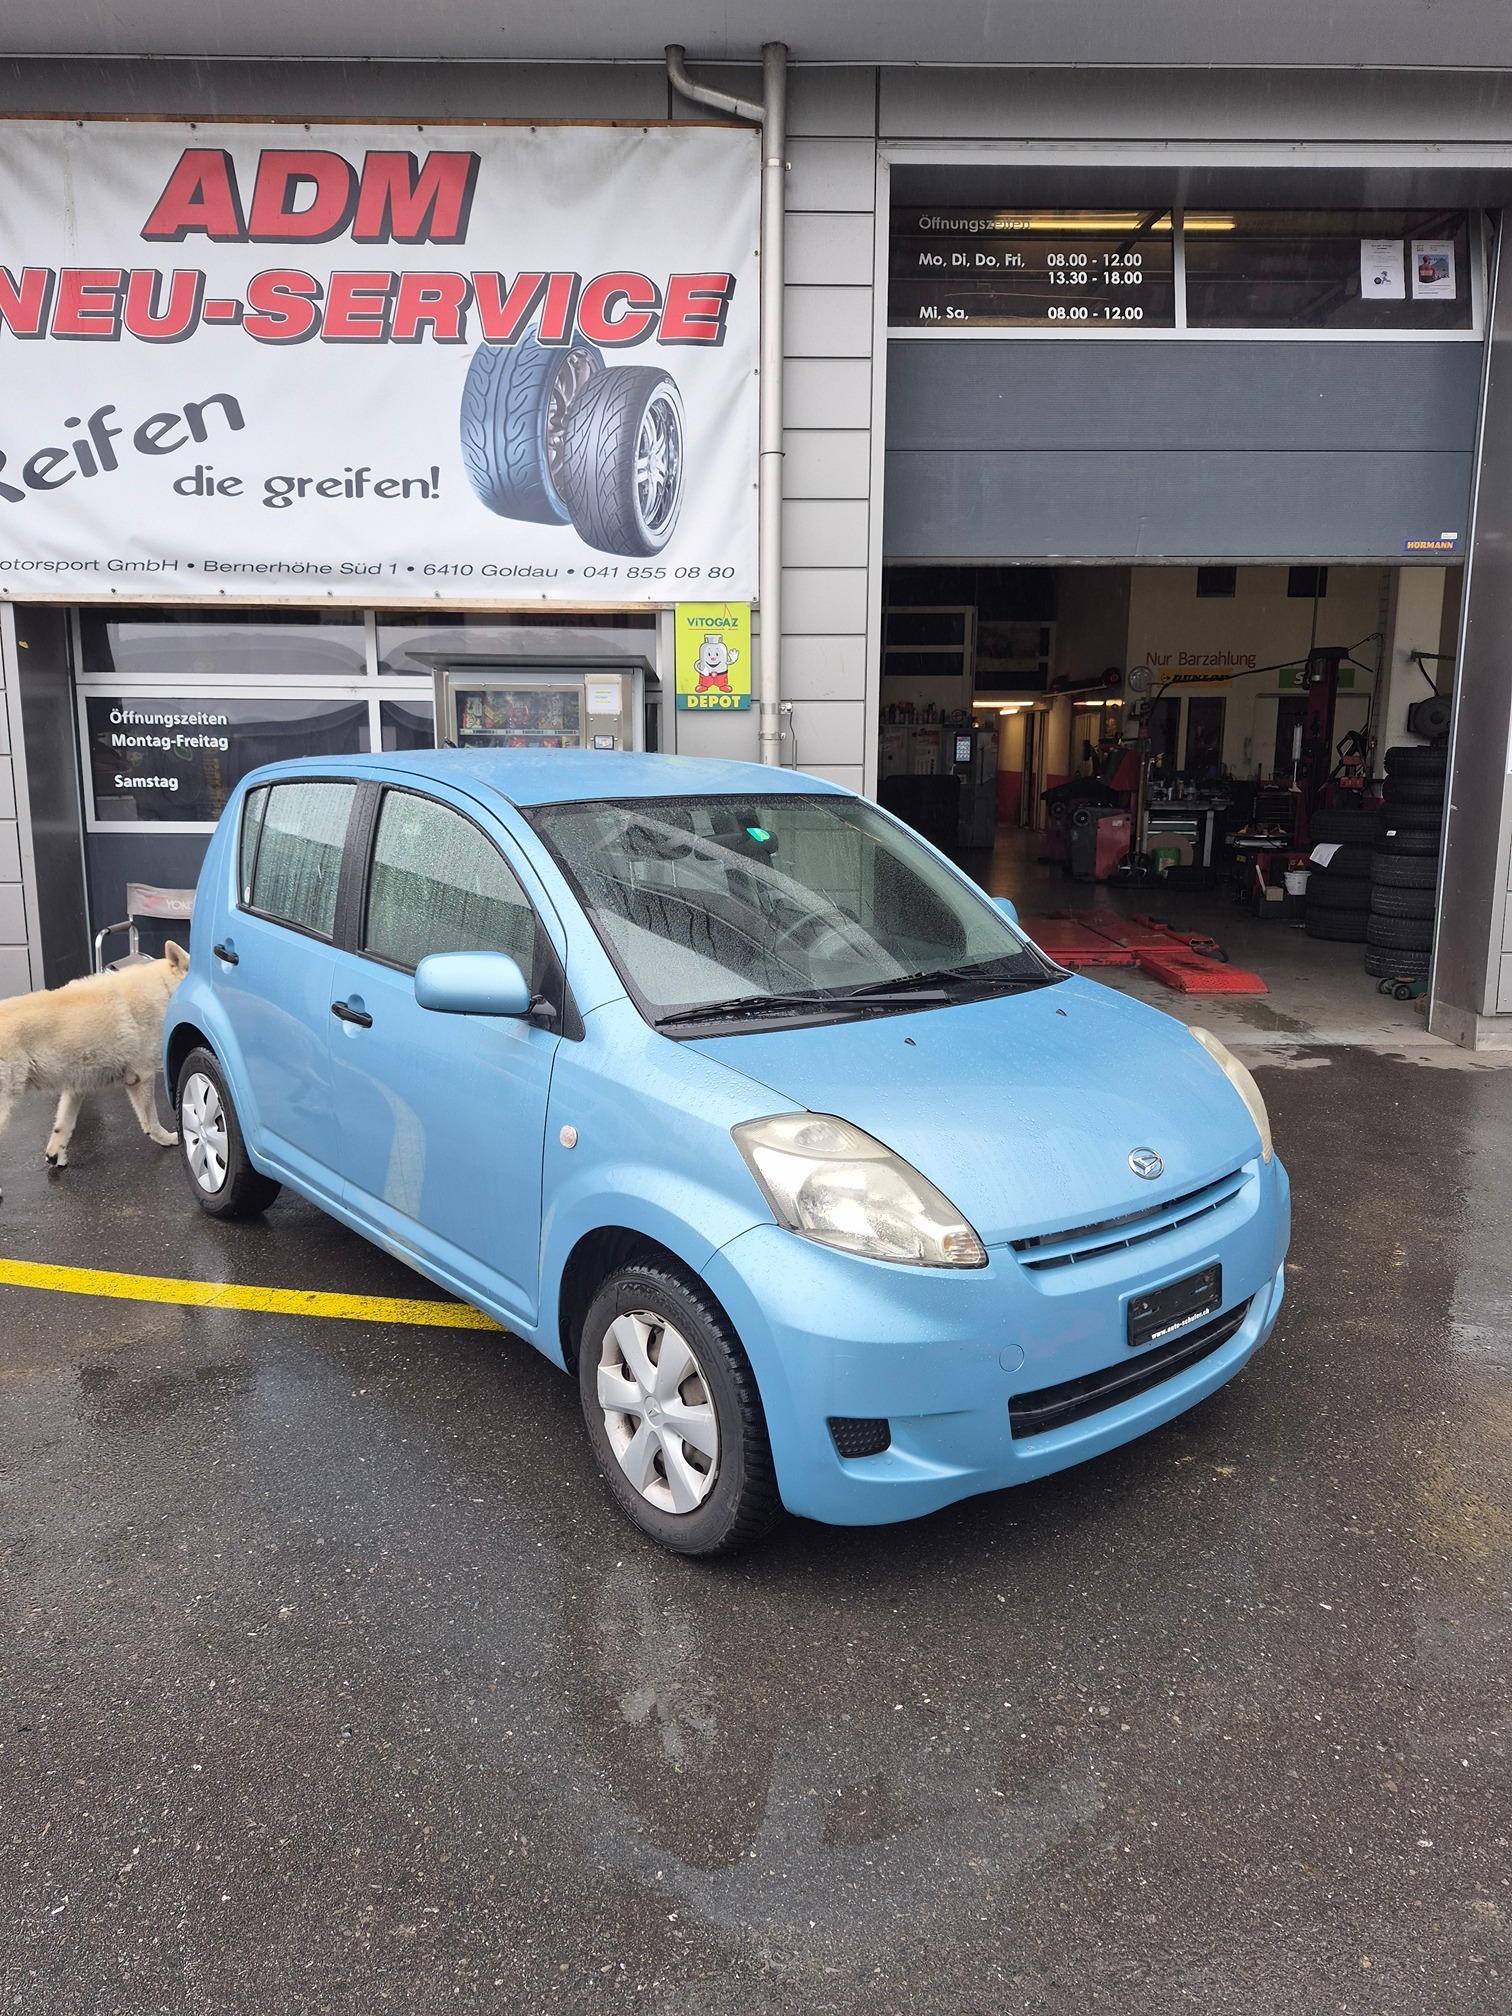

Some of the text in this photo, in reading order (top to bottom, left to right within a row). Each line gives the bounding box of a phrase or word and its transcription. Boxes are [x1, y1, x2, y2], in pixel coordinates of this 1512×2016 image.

[141, 147, 482, 245] ADM
[918, 214, 1031, 232] Öffnungszeiten
[919, 253, 947, 268] Mo,
[951, 253, 970, 268] Di,
[976, 253, 1000, 268] Do,
[1005, 253, 1025, 268] Fri,
[1047, 253, 1087, 267] 08.00
[1103, 253, 1142, 267] 12.00
[1048, 271, 1088, 285] 13.30
[1103, 271, 1143, 285] 18.00
[919, 306, 941, 320] Mi,
[946, 306, 969, 320] Sa,
[1047, 306, 1088, 320] 08.00
[1103, 306, 1143, 320] 12.00
[172, 464, 440, 509] die greifen!
[0, 558, 735, 580] otorsport GmbH Bernerhöhe Süd 1 6410 Goldau 041 855 08 80
[1146, 650, 1256, 668] Nur Barzahlung
[687, 695, 741, 708] DEPOT
[109, 708, 228, 727] Öffnungszeiten
[111, 733, 229, 751] Montag-Freitag
[114, 775, 179, 791] Samstag
